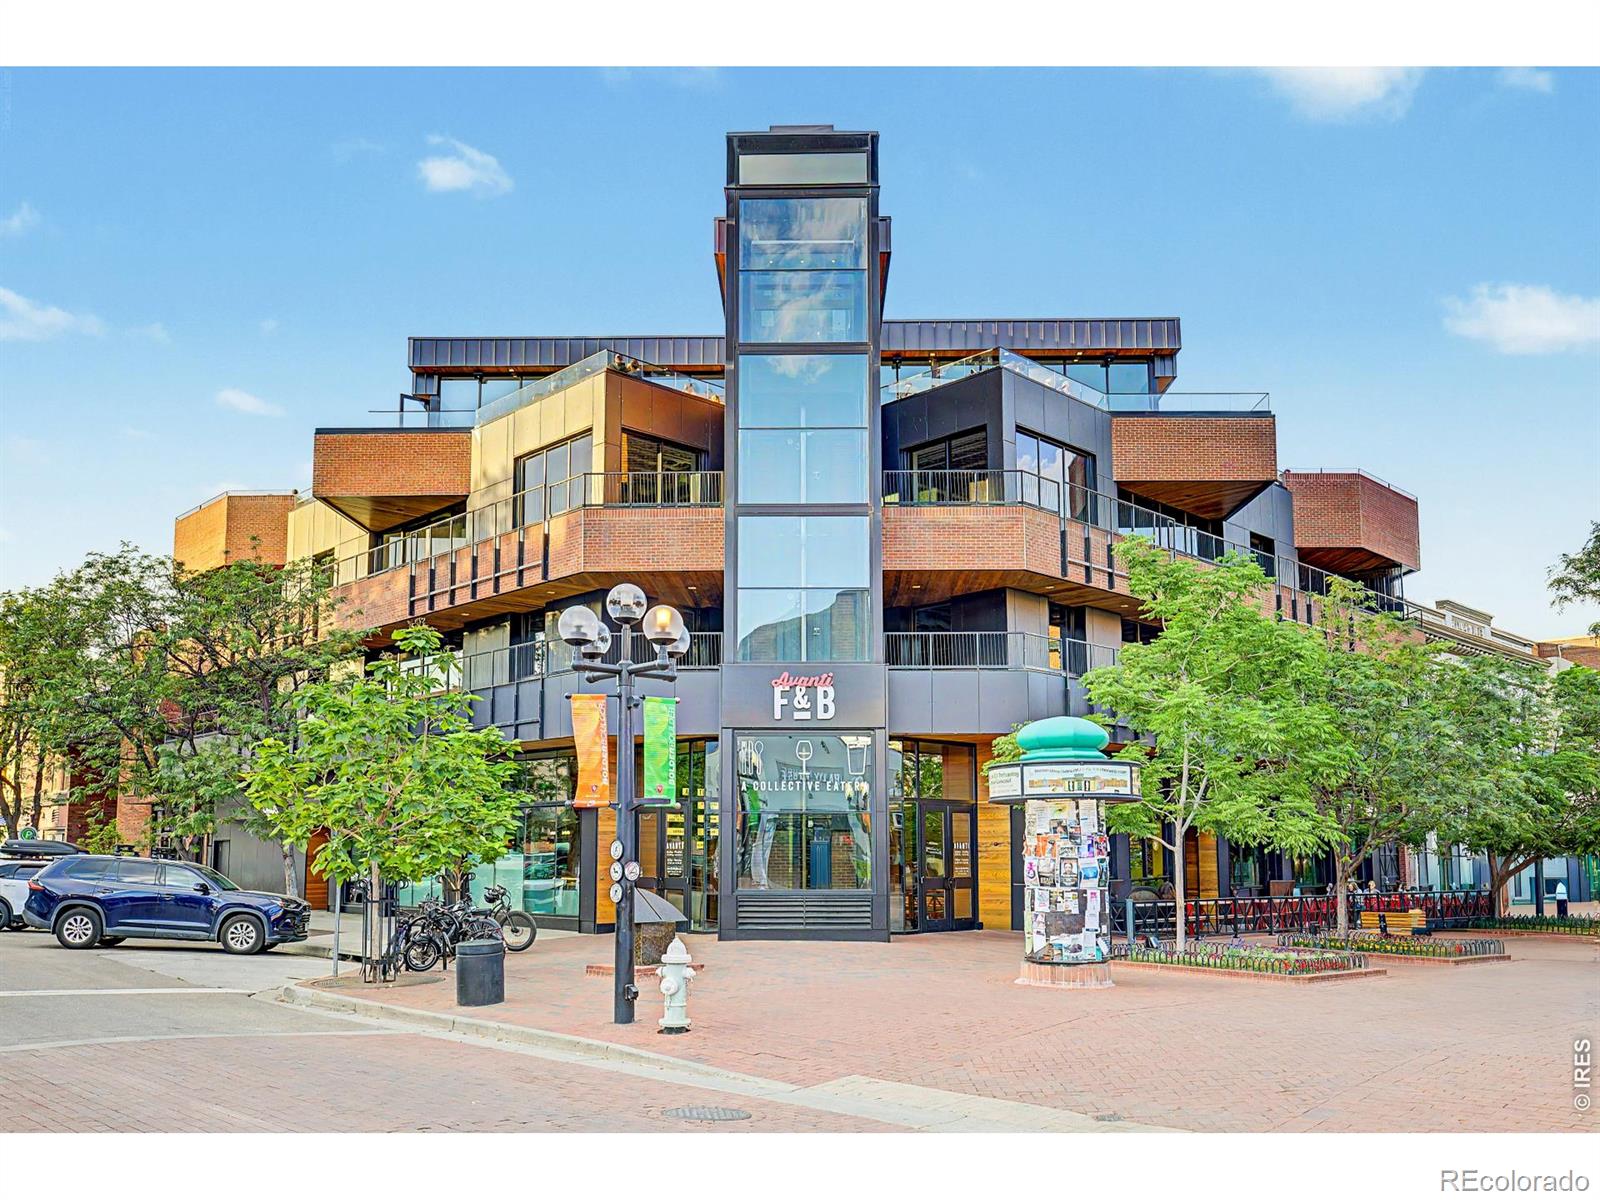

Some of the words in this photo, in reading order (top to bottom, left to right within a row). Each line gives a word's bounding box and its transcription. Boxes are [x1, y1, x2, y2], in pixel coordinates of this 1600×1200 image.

[771, 671, 834, 688] Avanti
[740, 780, 747, 791] A
[753, 780, 820, 791] COLLECTIVE
